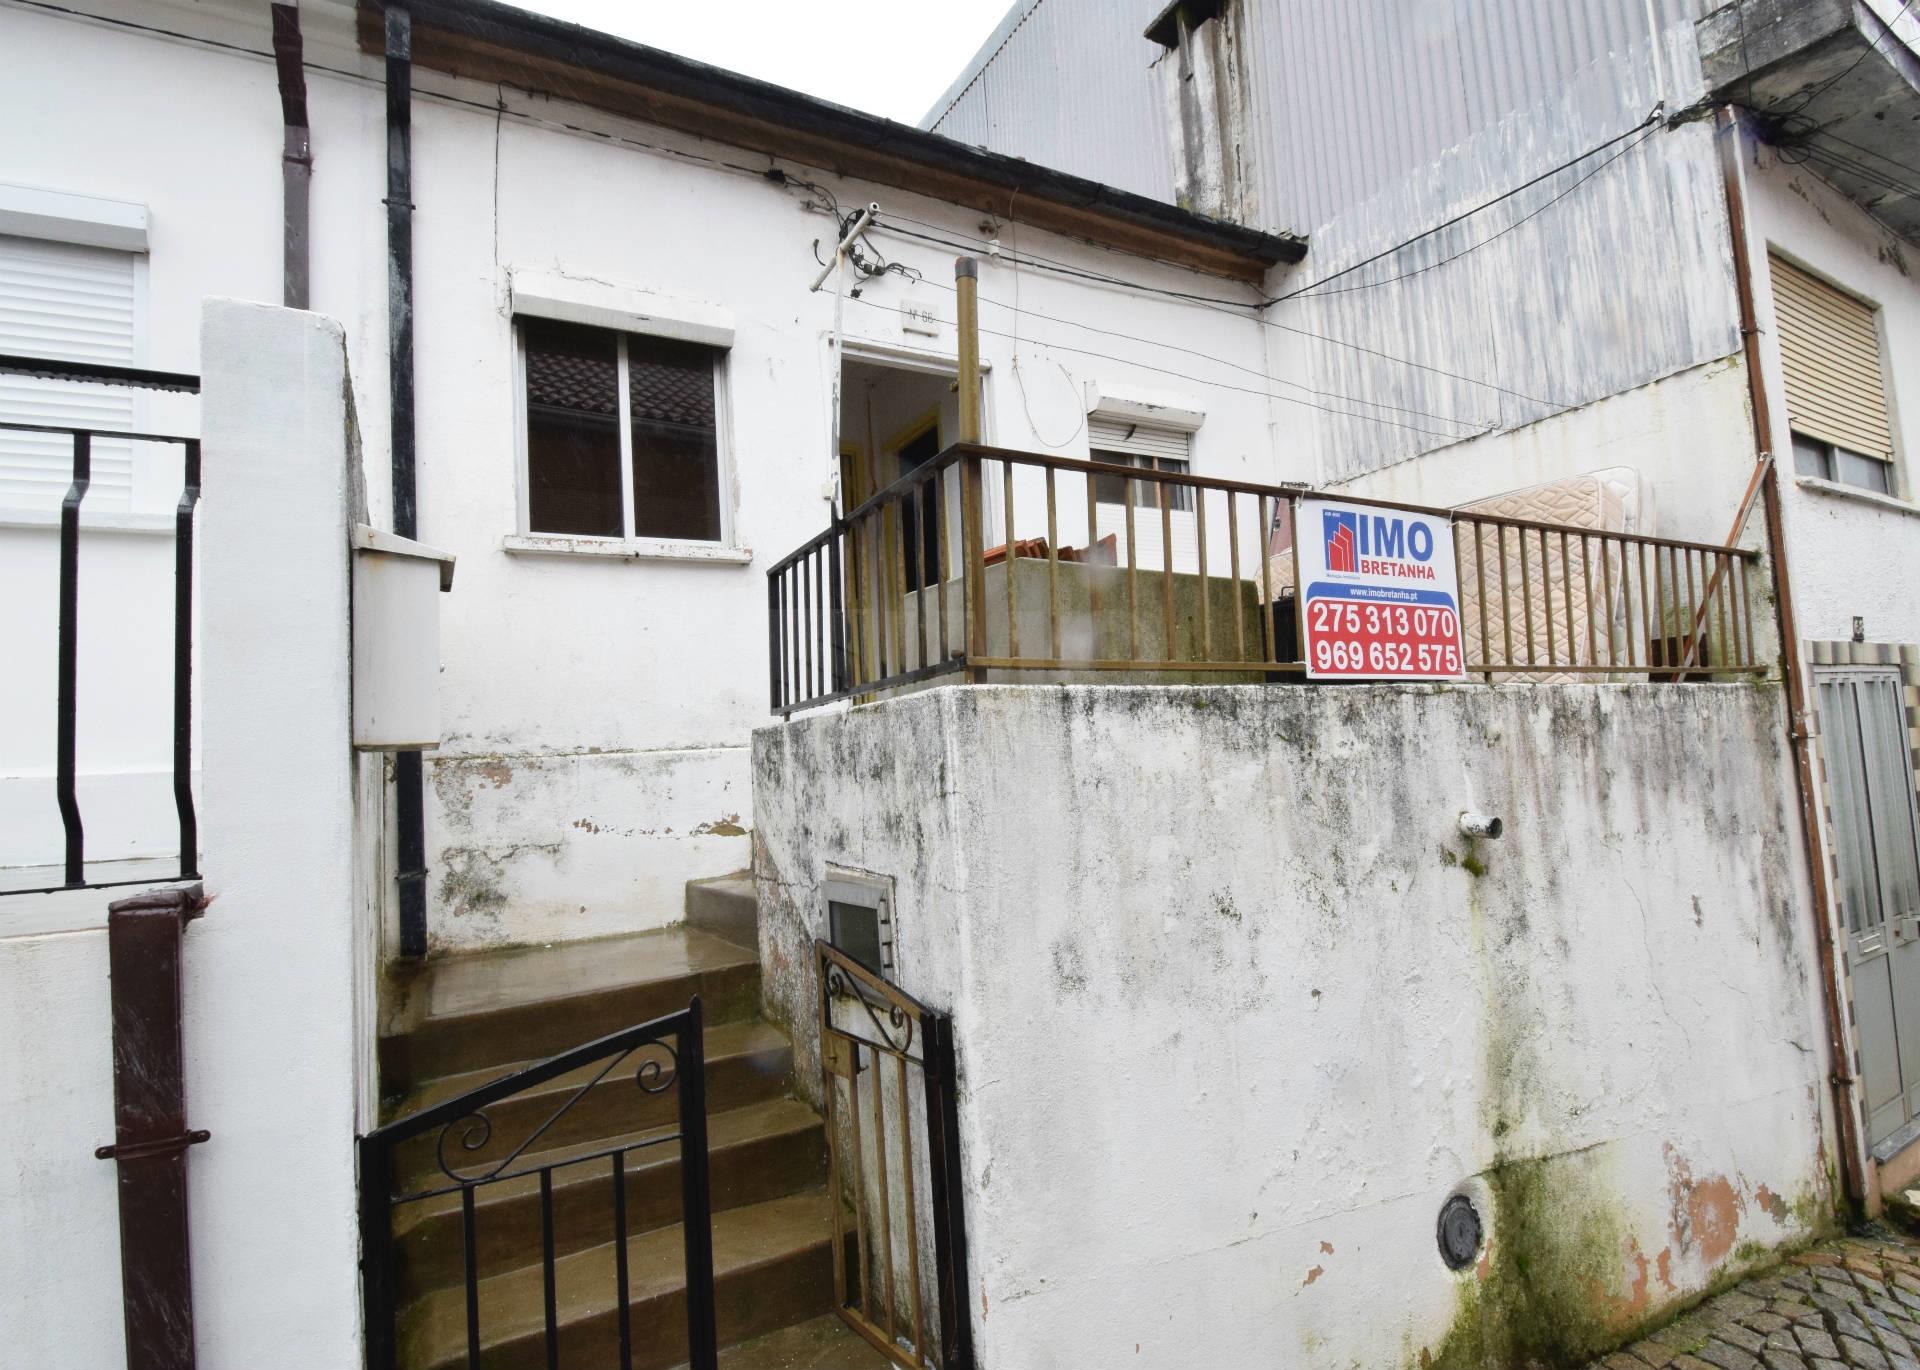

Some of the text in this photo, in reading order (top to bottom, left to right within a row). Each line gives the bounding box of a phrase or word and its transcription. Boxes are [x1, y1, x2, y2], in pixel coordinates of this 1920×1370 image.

[1359, 514, 1434, 562] IMO
[1361, 560, 1436, 580] BRETANHA
[1350, 588, 1418, 601] www.imobretanha.pt
[1313, 602, 1455, 638] 275 313 070
[1316, 640, 1458, 672] 969 652 575
